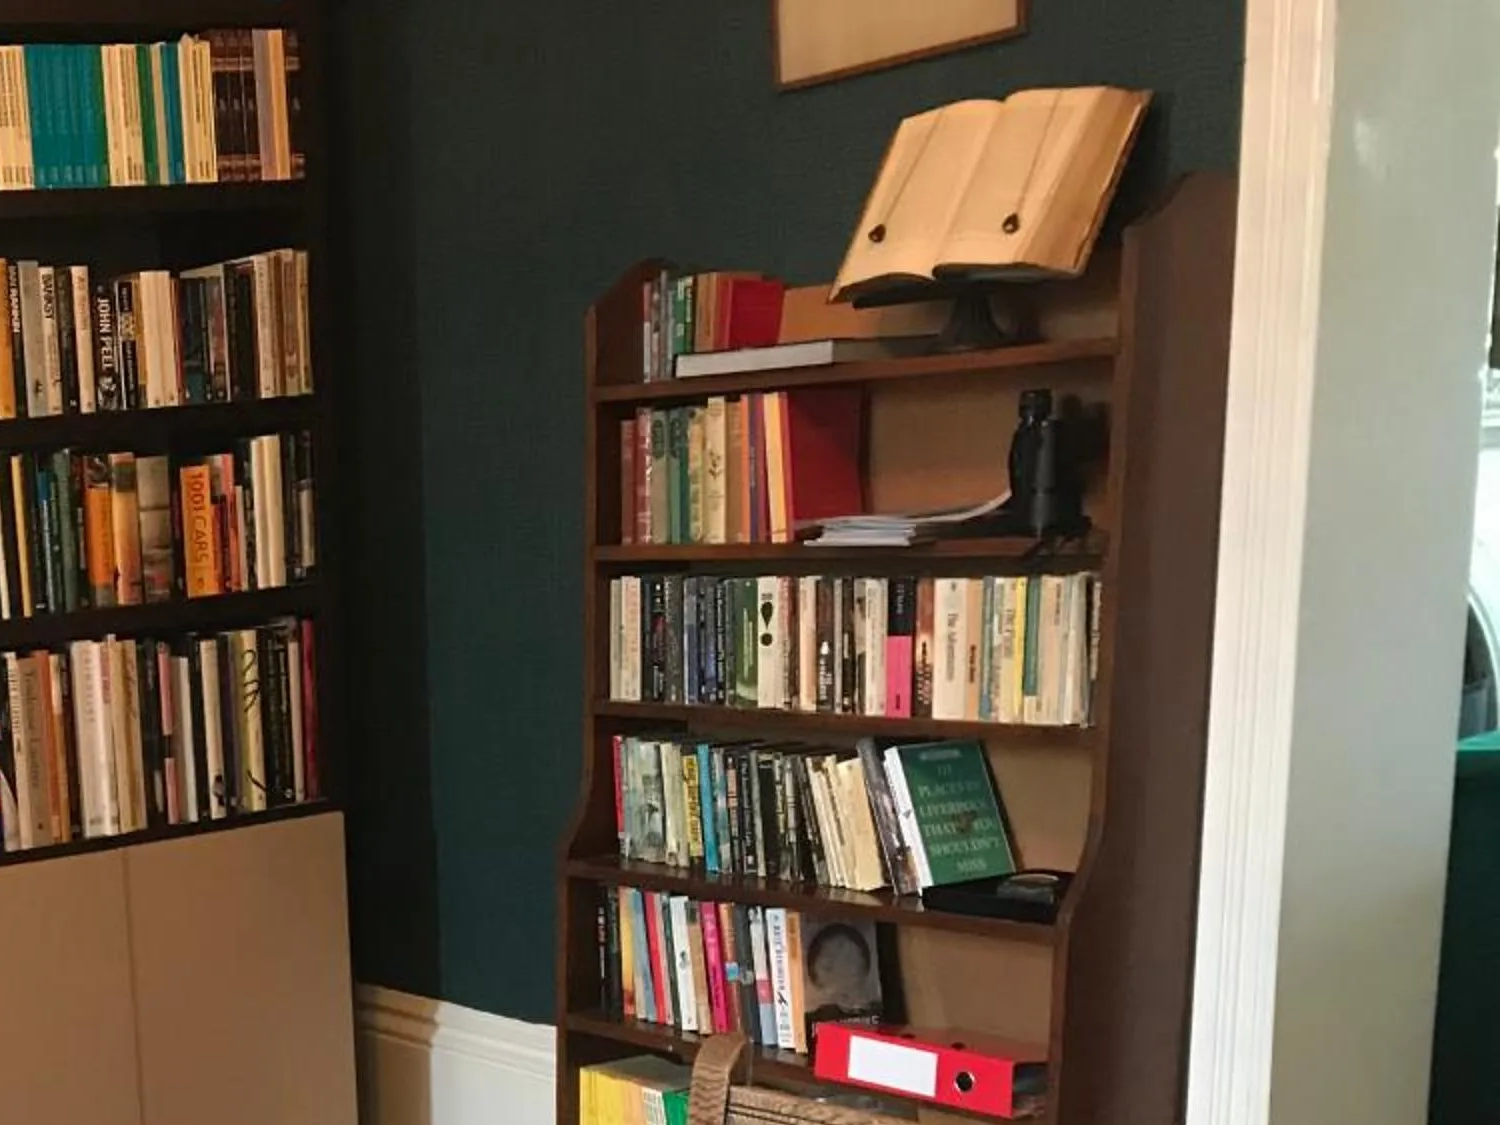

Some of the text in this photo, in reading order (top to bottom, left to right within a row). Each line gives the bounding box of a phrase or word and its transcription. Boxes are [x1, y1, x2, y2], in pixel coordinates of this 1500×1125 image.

[97, 298, 113, 370] JOHN PEEL
[190, 472, 209, 563] 1001 CARS
